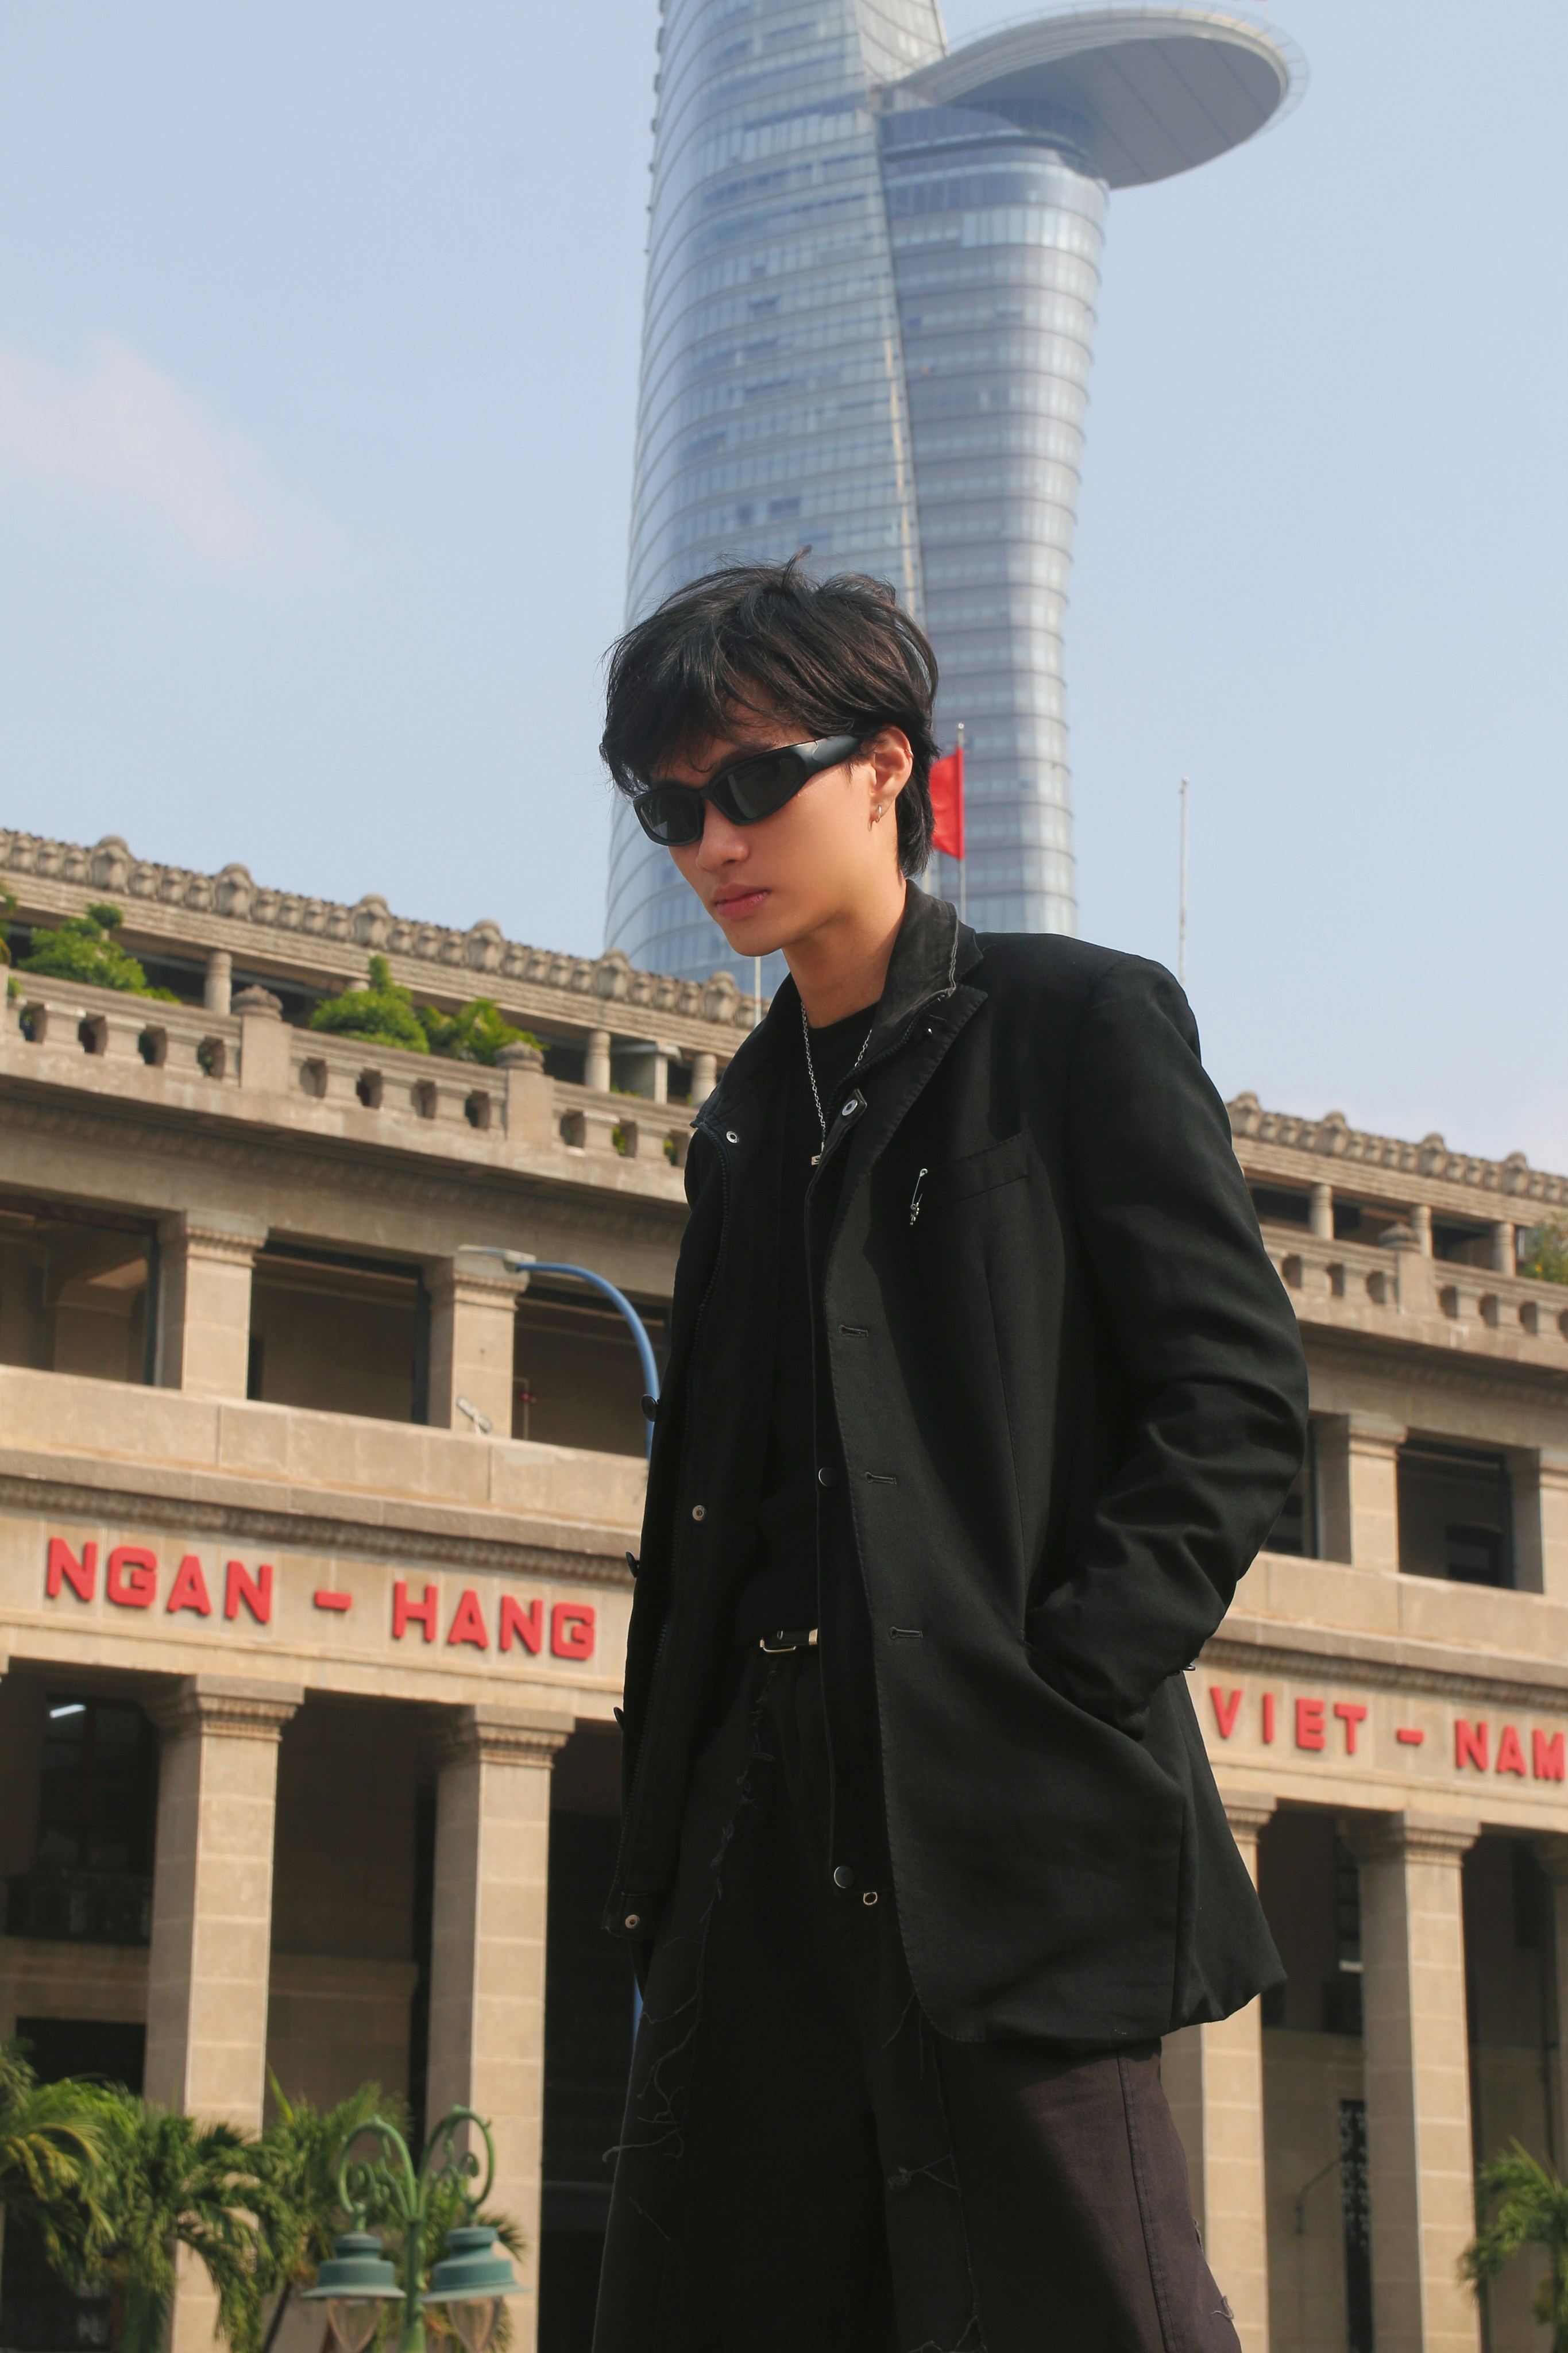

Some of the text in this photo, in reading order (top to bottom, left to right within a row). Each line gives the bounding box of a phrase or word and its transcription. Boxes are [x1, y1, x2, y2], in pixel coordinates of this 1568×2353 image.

[46, 1536, 275, 1623] NGAN
[393, 1580, 596, 1661] HANG
[1210, 1685, 1368, 1754] VIET
[1454, 1718, 1567, 1781] NAM
